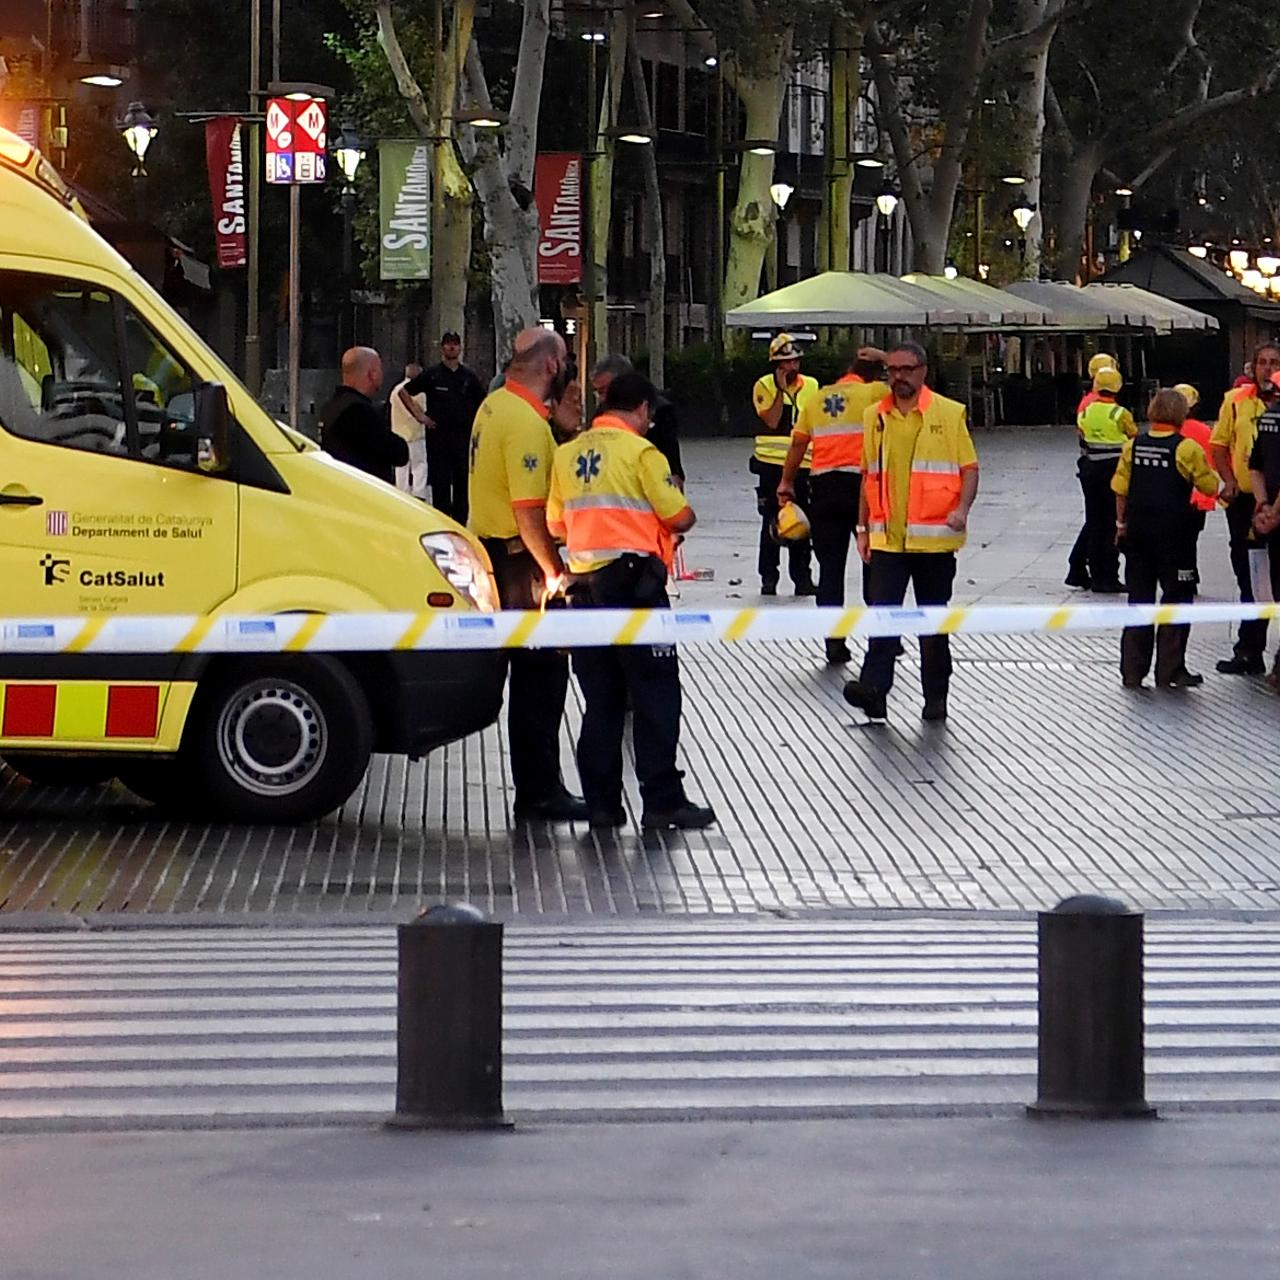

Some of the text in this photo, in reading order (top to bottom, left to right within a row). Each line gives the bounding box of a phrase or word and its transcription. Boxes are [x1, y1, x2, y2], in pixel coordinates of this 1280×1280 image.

[309, 112, 320, 129] M
[72, 512, 213, 527] Generalitat de Catalunya
[72, 526, 202, 539] Departament de Salut
[79, 570, 165, 587] CatSalut
